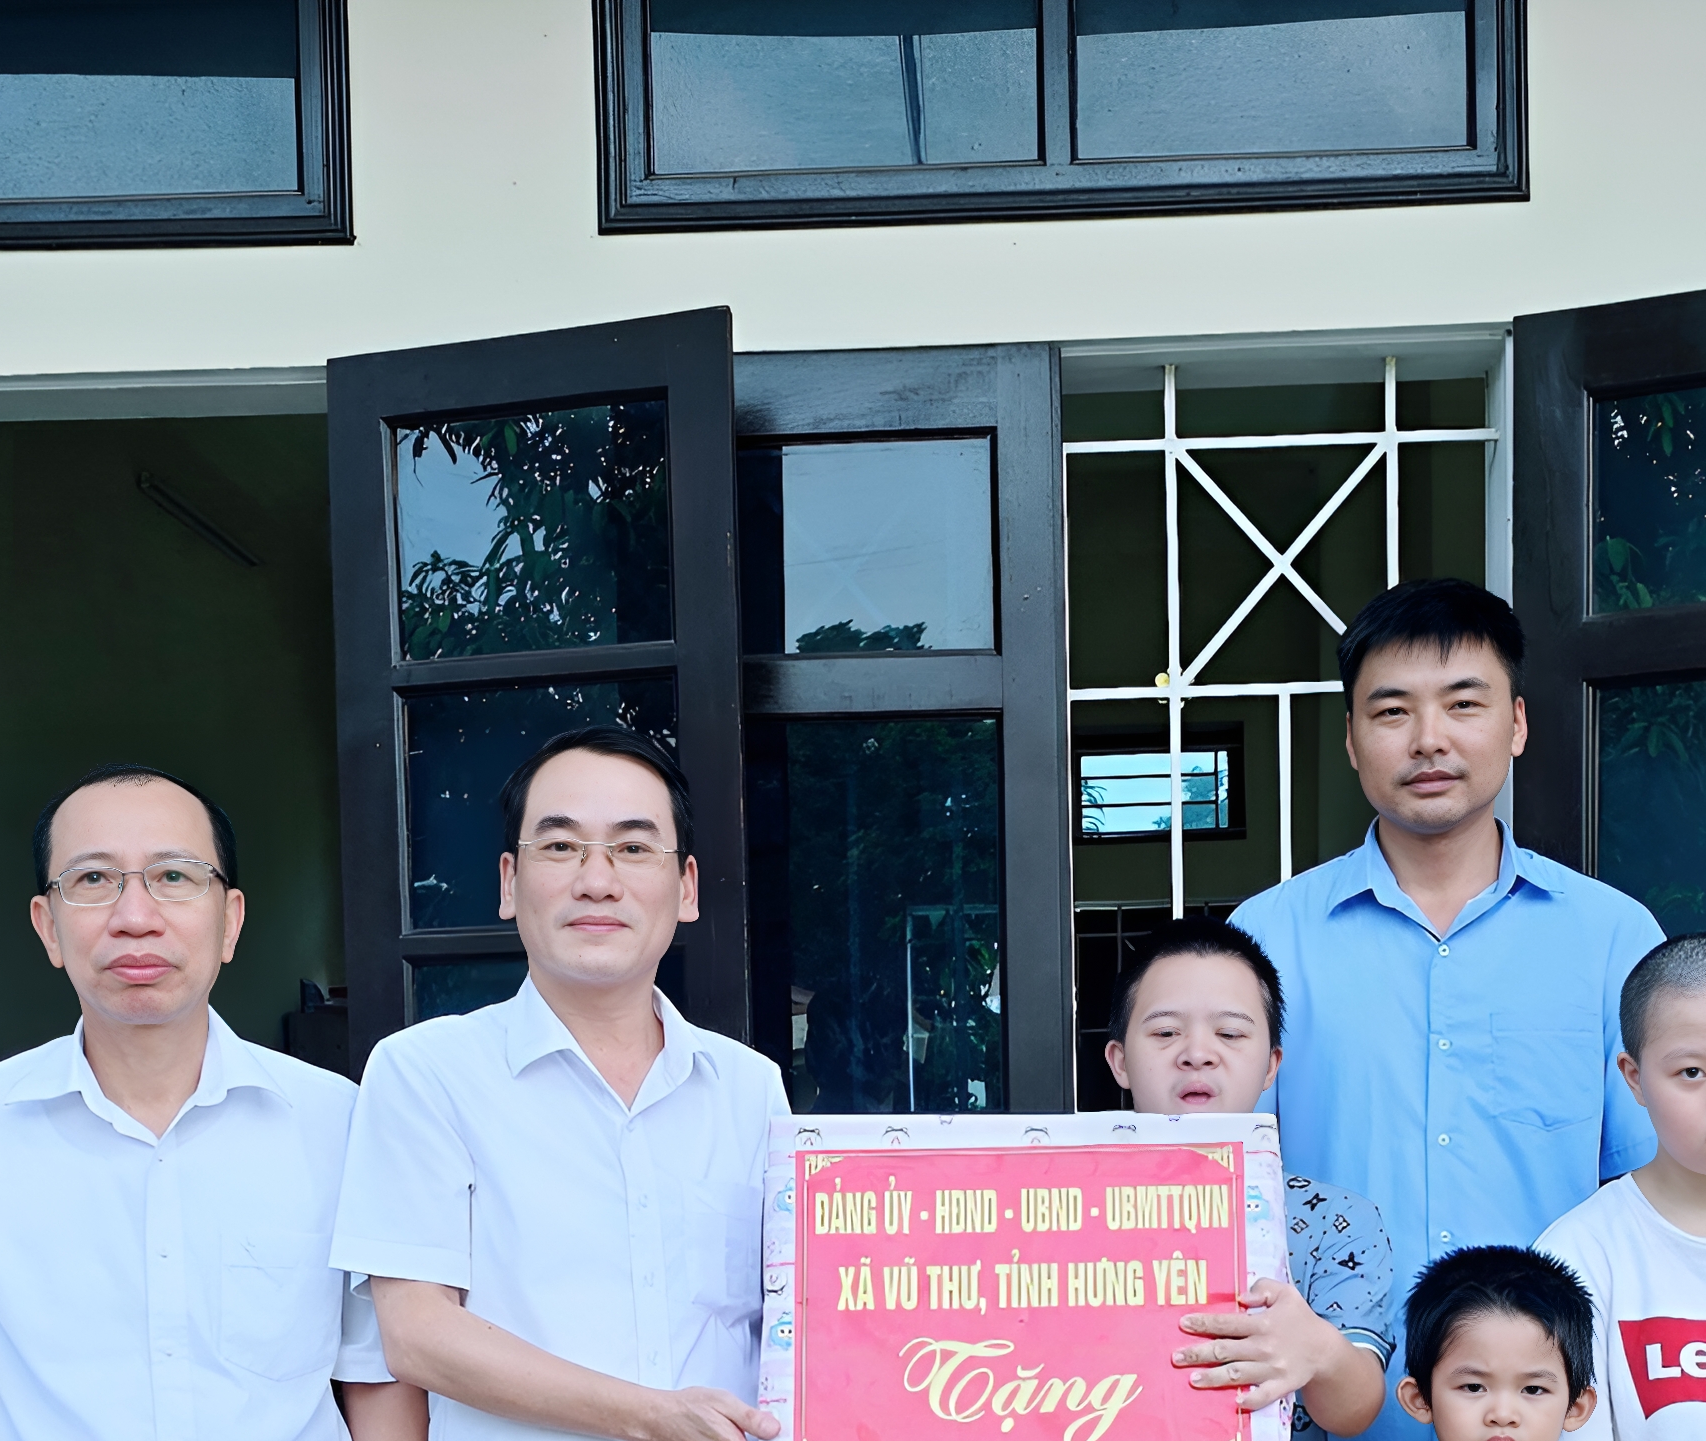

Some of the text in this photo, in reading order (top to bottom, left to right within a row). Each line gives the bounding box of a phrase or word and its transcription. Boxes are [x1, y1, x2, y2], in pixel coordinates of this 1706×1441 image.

[815, 1177, 877, 1235] ĐẢNG
[884, 1175, 913, 1235] ỦY
[935, 1189, 998, 1234] HĐND
[1020, 1187, 1083, 1233] UBND
[1105, 1184, 1229, 1234] UBMTTQVN
[837, 1248, 1207, 1316] XÃ VŨ THƯ, TỈNH HƯNG YÊN
